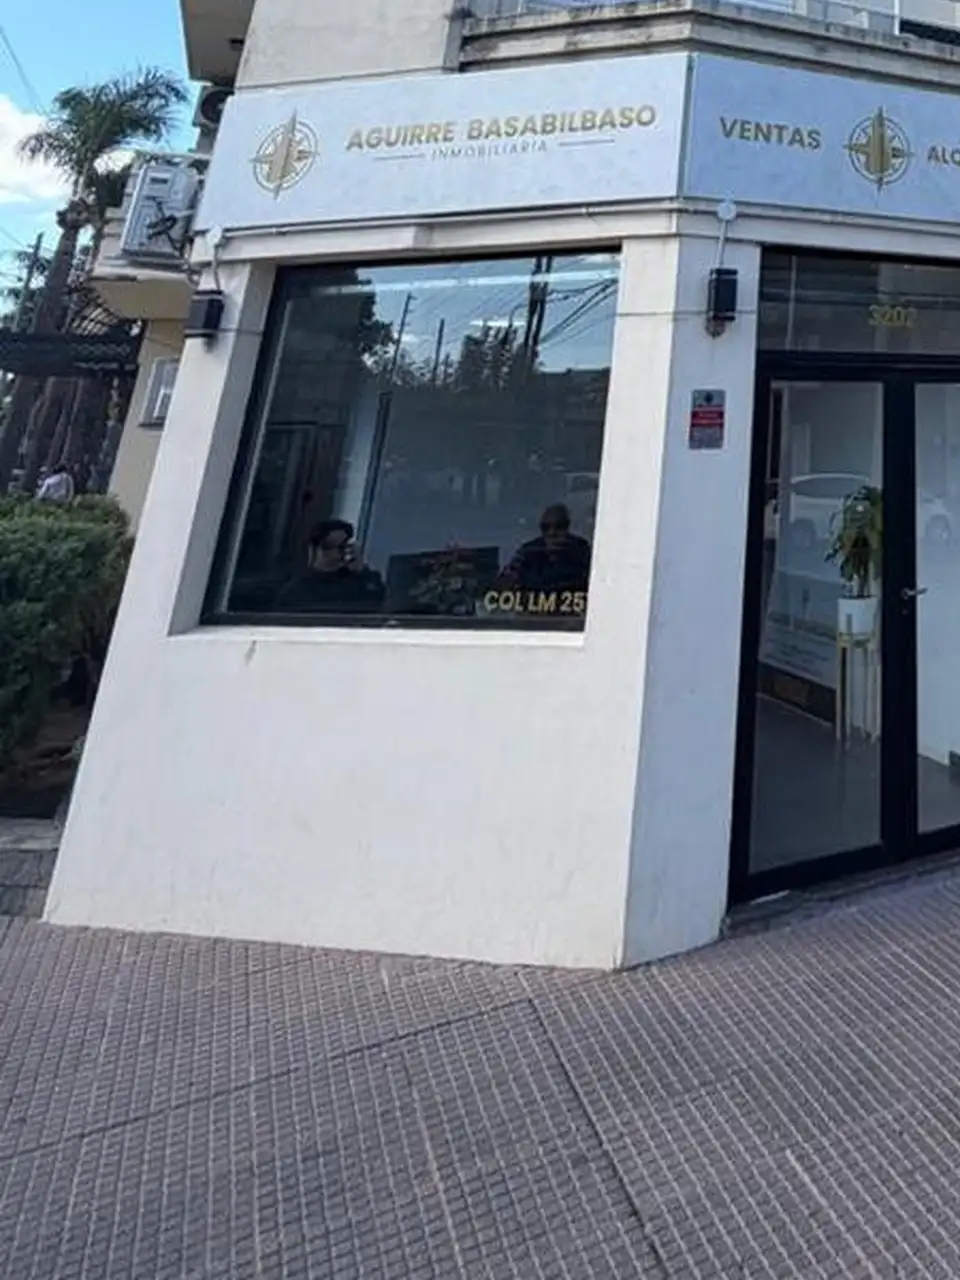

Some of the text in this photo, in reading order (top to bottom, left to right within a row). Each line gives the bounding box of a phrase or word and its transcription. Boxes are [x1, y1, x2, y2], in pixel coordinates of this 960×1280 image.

[345, 104, 656, 152] AGUIRRE BASABILBASO
[719, 116, 822, 150] VENTAS
[431, 139, 548, 161] INMOBILIARIA
[484, 590, 588, 613] COL LM 25
